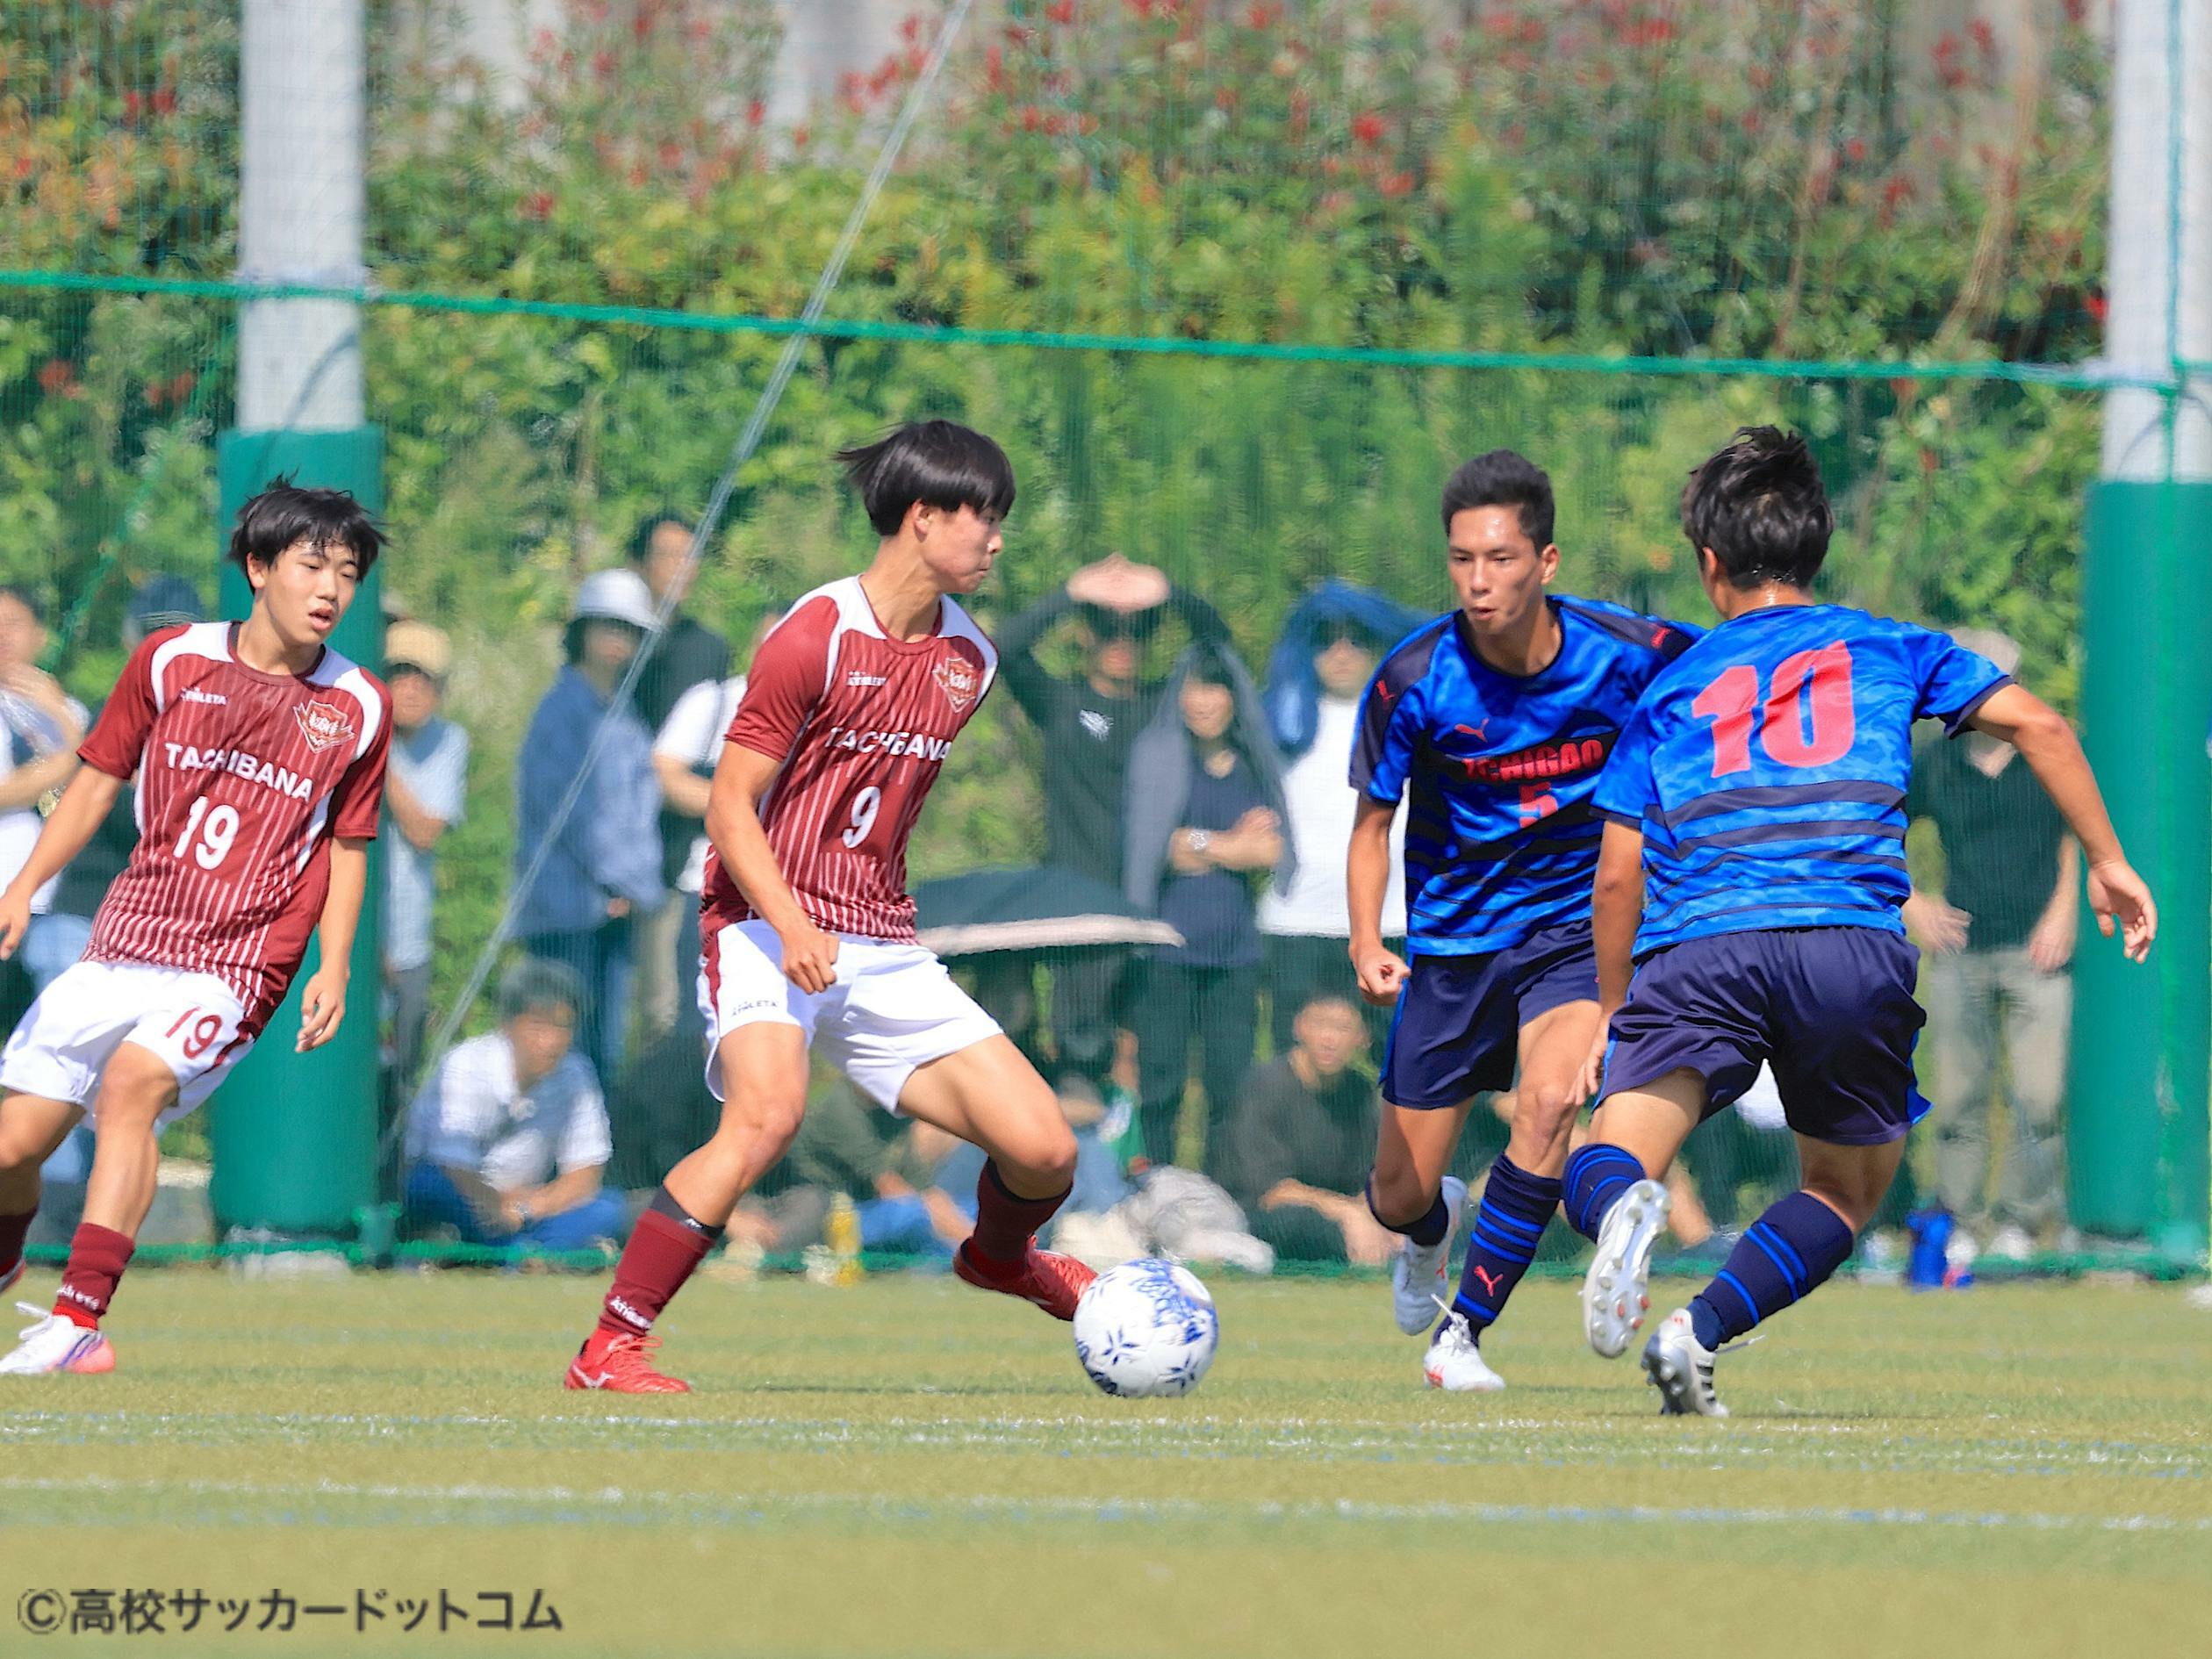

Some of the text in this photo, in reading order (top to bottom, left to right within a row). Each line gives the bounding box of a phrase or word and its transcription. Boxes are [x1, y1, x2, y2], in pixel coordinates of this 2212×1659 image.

[1691, 639, 1856, 779] 10
[165, 743, 314, 802] TACHIBANA
[173, 796, 241, 871] 19
[842, 785, 881, 849] 9
[1519, 781, 1559, 829] 5
[163, 1005, 222, 1059] 19
